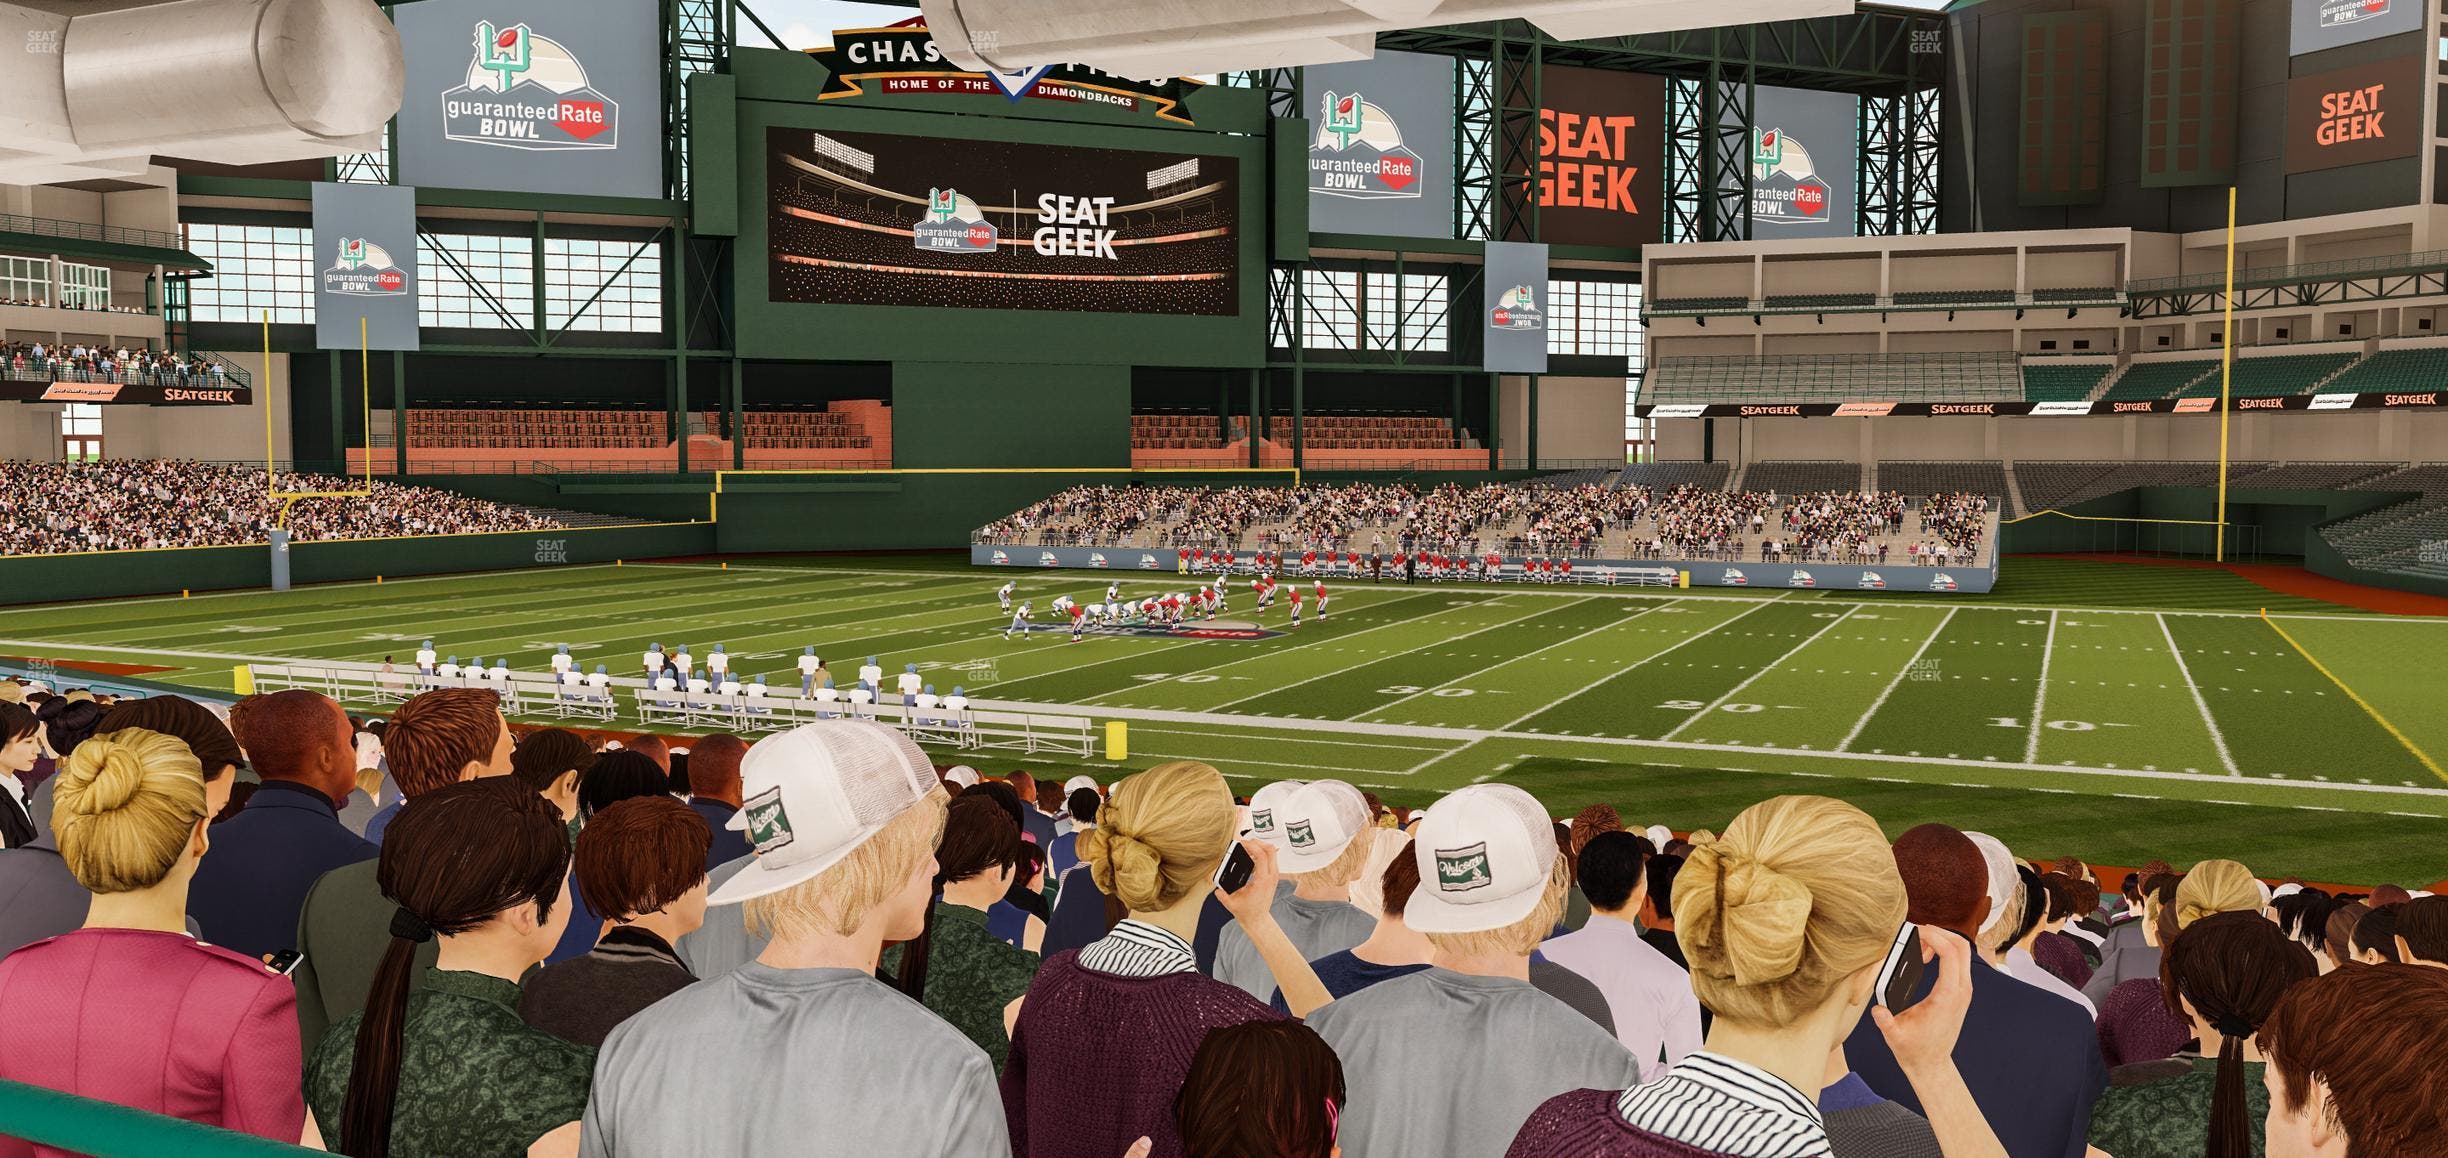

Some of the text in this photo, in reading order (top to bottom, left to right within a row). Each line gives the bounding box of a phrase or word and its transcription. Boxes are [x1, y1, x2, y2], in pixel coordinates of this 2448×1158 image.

[2334, 9, 2358, 22] BOWL
[848, 40, 951, 64] CHAS
[889, 79, 1132, 107] HOME OF THE DIAMONDBACKS
[2321, 84, 2385, 120] SEAT
[447, 100, 603, 123] guaranteed Rate
[479, 118, 540, 139] BOWL
[1530, 108, 1636, 161] SEAT
[2316, 111, 2385, 146] GEEK
[1309, 158, 1412, 176] uaranteed Rate
[1324, 172, 1367, 189] BOWL
[1522, 161, 1639, 215] GEEK
[1797, 188, 1822, 203] Rate
[1038, 193, 1115, 226] SEAT
[1751, 200, 1785, 215] BOWL
[916, 227, 990, 240] guaranteed Rate
[931, 236, 960, 248] BOWL
[1033, 226, 1118, 261] GEEK
[326, 273, 401, 283] guaranteed Rate
[341, 281, 371, 291] BOWL
[164, 387, 235, 403] SEATGEEK
[2239, 397, 2284, 409] SEATGEEK
[2385, 393, 2437, 406] SEATGEEK
[1740, 405, 1800, 415] SEATGEEK
[1931, 403, 1994, 414] SEATGEEK
[2113, 401, 2153, 413] SEATGEEK
